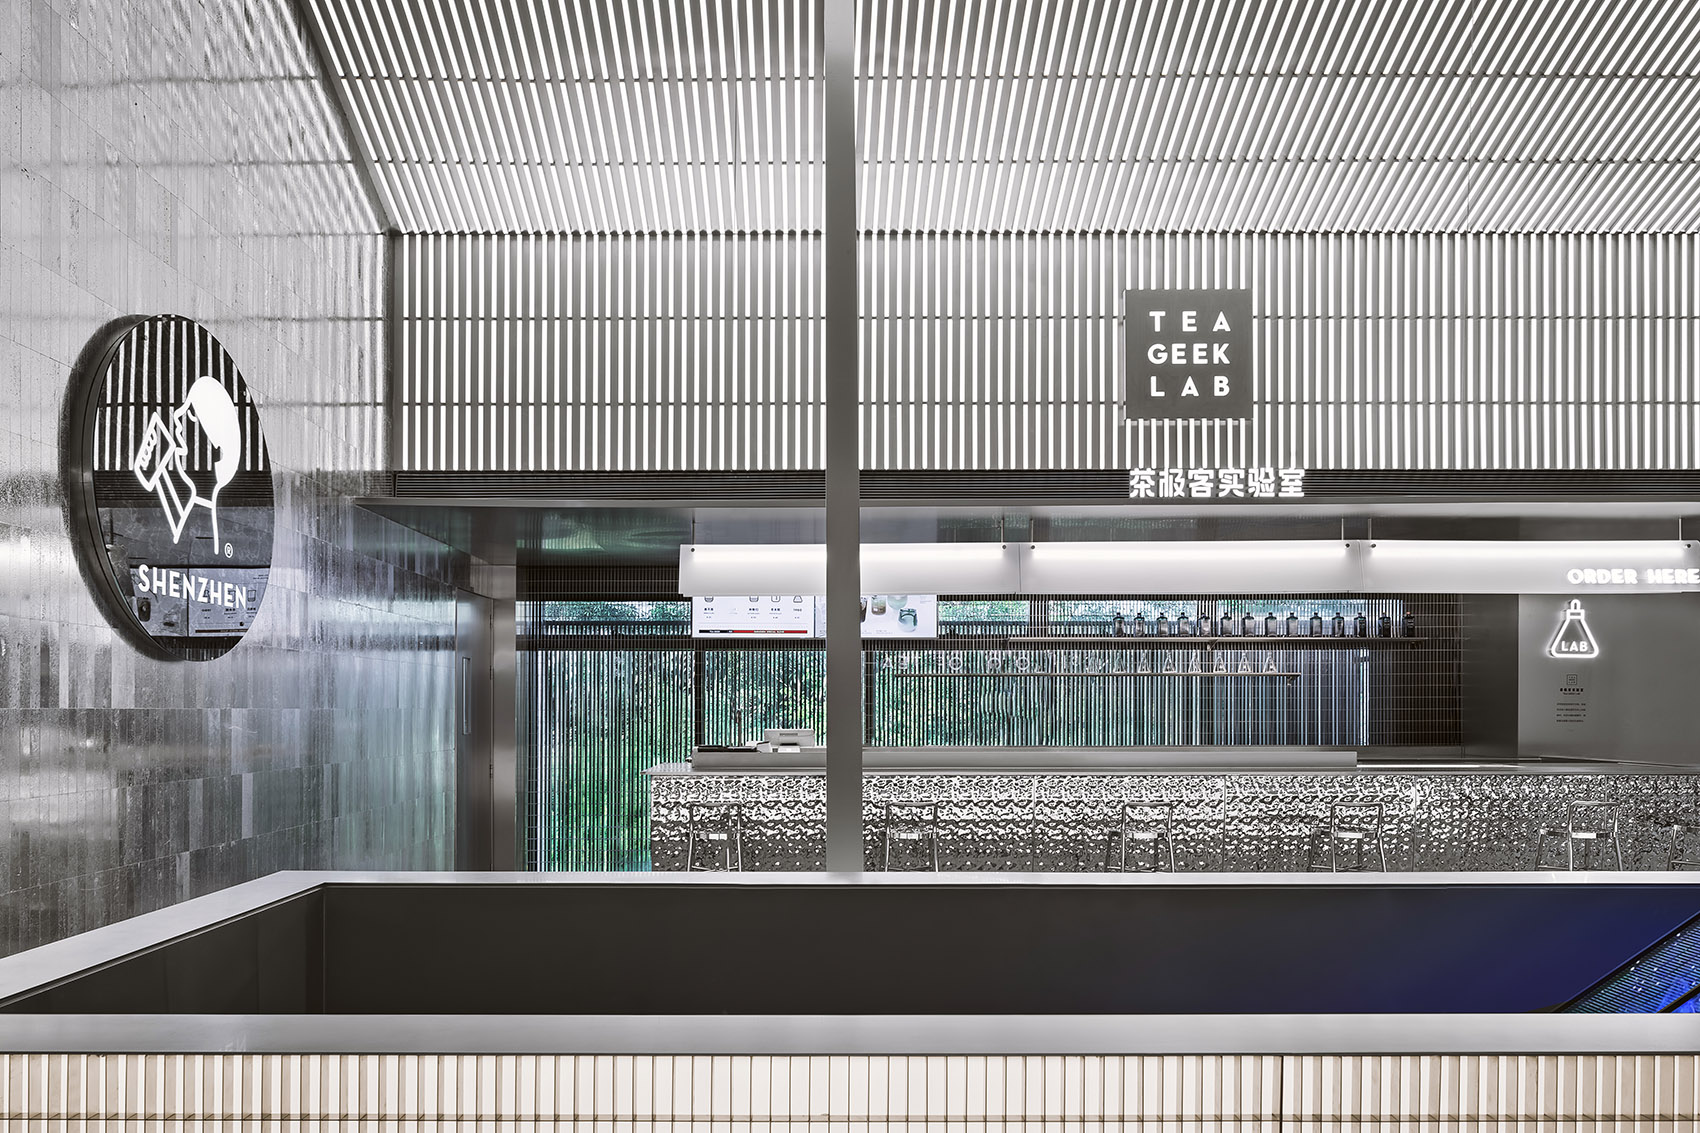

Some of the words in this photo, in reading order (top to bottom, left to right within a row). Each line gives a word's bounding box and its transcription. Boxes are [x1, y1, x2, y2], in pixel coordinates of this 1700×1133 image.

[1149, 311, 1231, 332] TEA
[1147, 343, 1230, 364] GEEK
[1150, 375, 1230, 397] LAB
[1129, 468, 1305, 498] 茶极客实验室
[138, 564, 246, 609] SHENZHEN
[1567, 568, 1638, 584] ORDER
[1647, 568, 1700, 584] HERE
[1561, 640, 1588, 652] LAB
